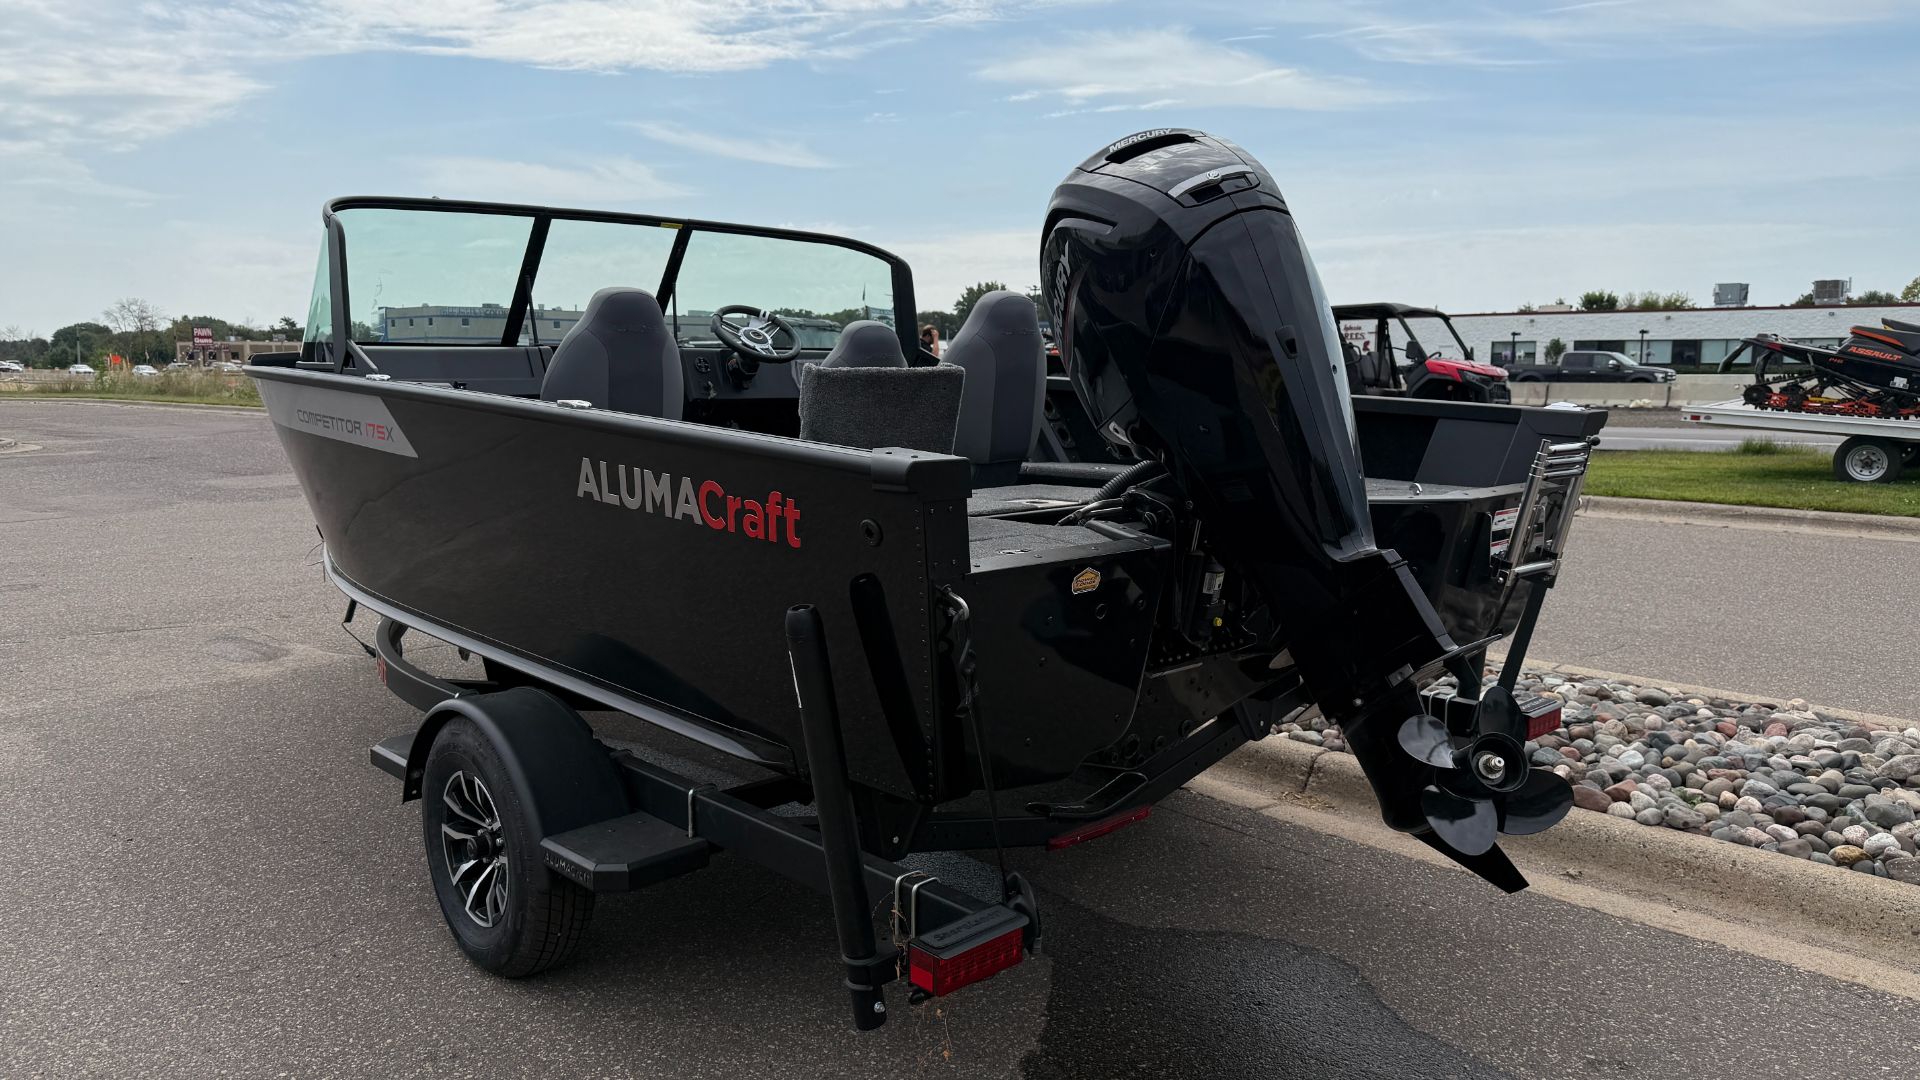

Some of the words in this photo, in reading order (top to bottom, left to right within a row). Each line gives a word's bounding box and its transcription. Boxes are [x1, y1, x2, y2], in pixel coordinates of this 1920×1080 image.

[1109, 128, 1171, 153] MERCURY
[193, 327, 212, 336] PAWN
[1847, 346, 1903, 361] ASSAULT
[296, 409, 363, 436] COMPETITOR
[365, 422, 395, 443] 175X
[576, 457, 801, 549] ALUMACraft
